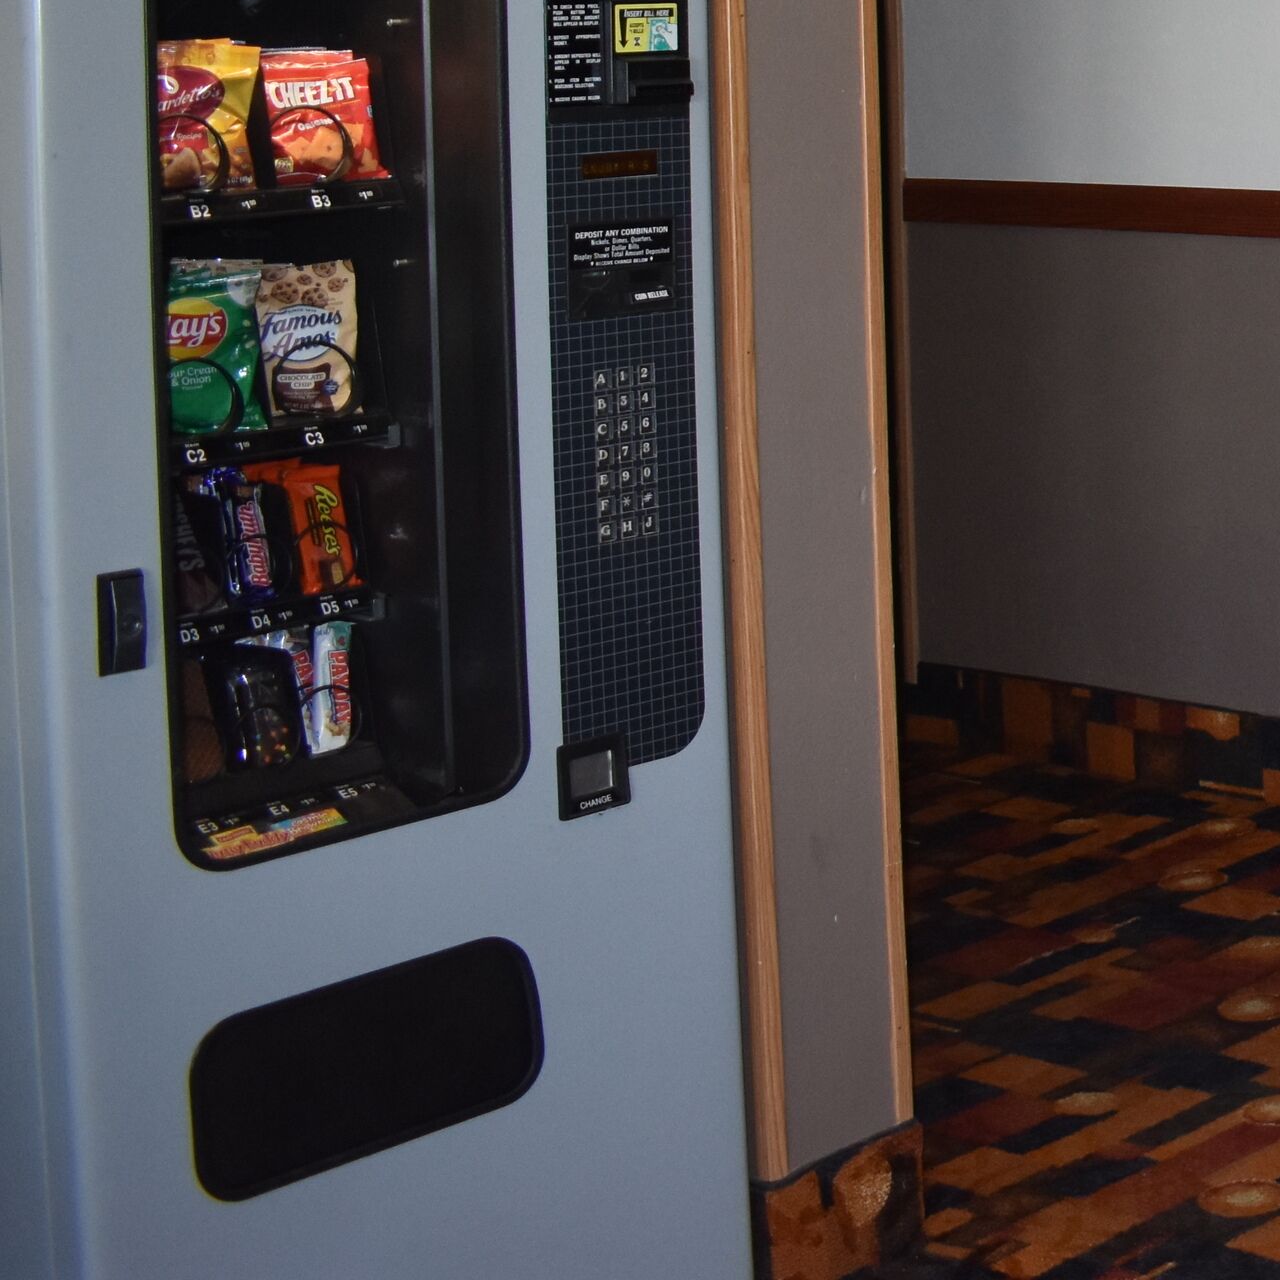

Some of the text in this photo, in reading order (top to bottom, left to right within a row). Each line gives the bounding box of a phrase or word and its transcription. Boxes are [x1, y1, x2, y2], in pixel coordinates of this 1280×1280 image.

[624, 9, 643, 17] INSERT
[656, 9, 670, 17] HERE
[157, 81, 221, 112] ardetto's
[311, 195, 331, 207] B3
[190, 205, 211, 218] B2
[575, 226, 669, 239] DEPOSIT ANY COMBINATION
[645, 247, 670, 255] Deposited
[634, 289, 669, 300] COIN RELEASE
[261, 309, 342, 340] Famous
[181, 375, 212, 386] Onion
[596, 367, 648, 384] A 1 2
[598, 399, 607, 409] B
[642, 393, 649, 403] 4
[598, 417, 649, 435] C 5 6
[305, 431, 324, 446] C3
[186, 450, 207, 463] C2
[599, 442, 650, 460] D 7 8
[600, 467, 651, 485] E 9 0
[601, 493, 652, 511] F #
[313, 485, 341, 557] Reese's
[601, 516, 652, 536] G H J
[320, 601, 340, 615] D5
[252, 616, 271, 629] D4
[180, 629, 199, 643] D3
[339, 788, 358, 800] E5
[580, 794, 613, 810] CHANGE
[269, 804, 289, 816] E4
[198, 822, 218, 834] E3
